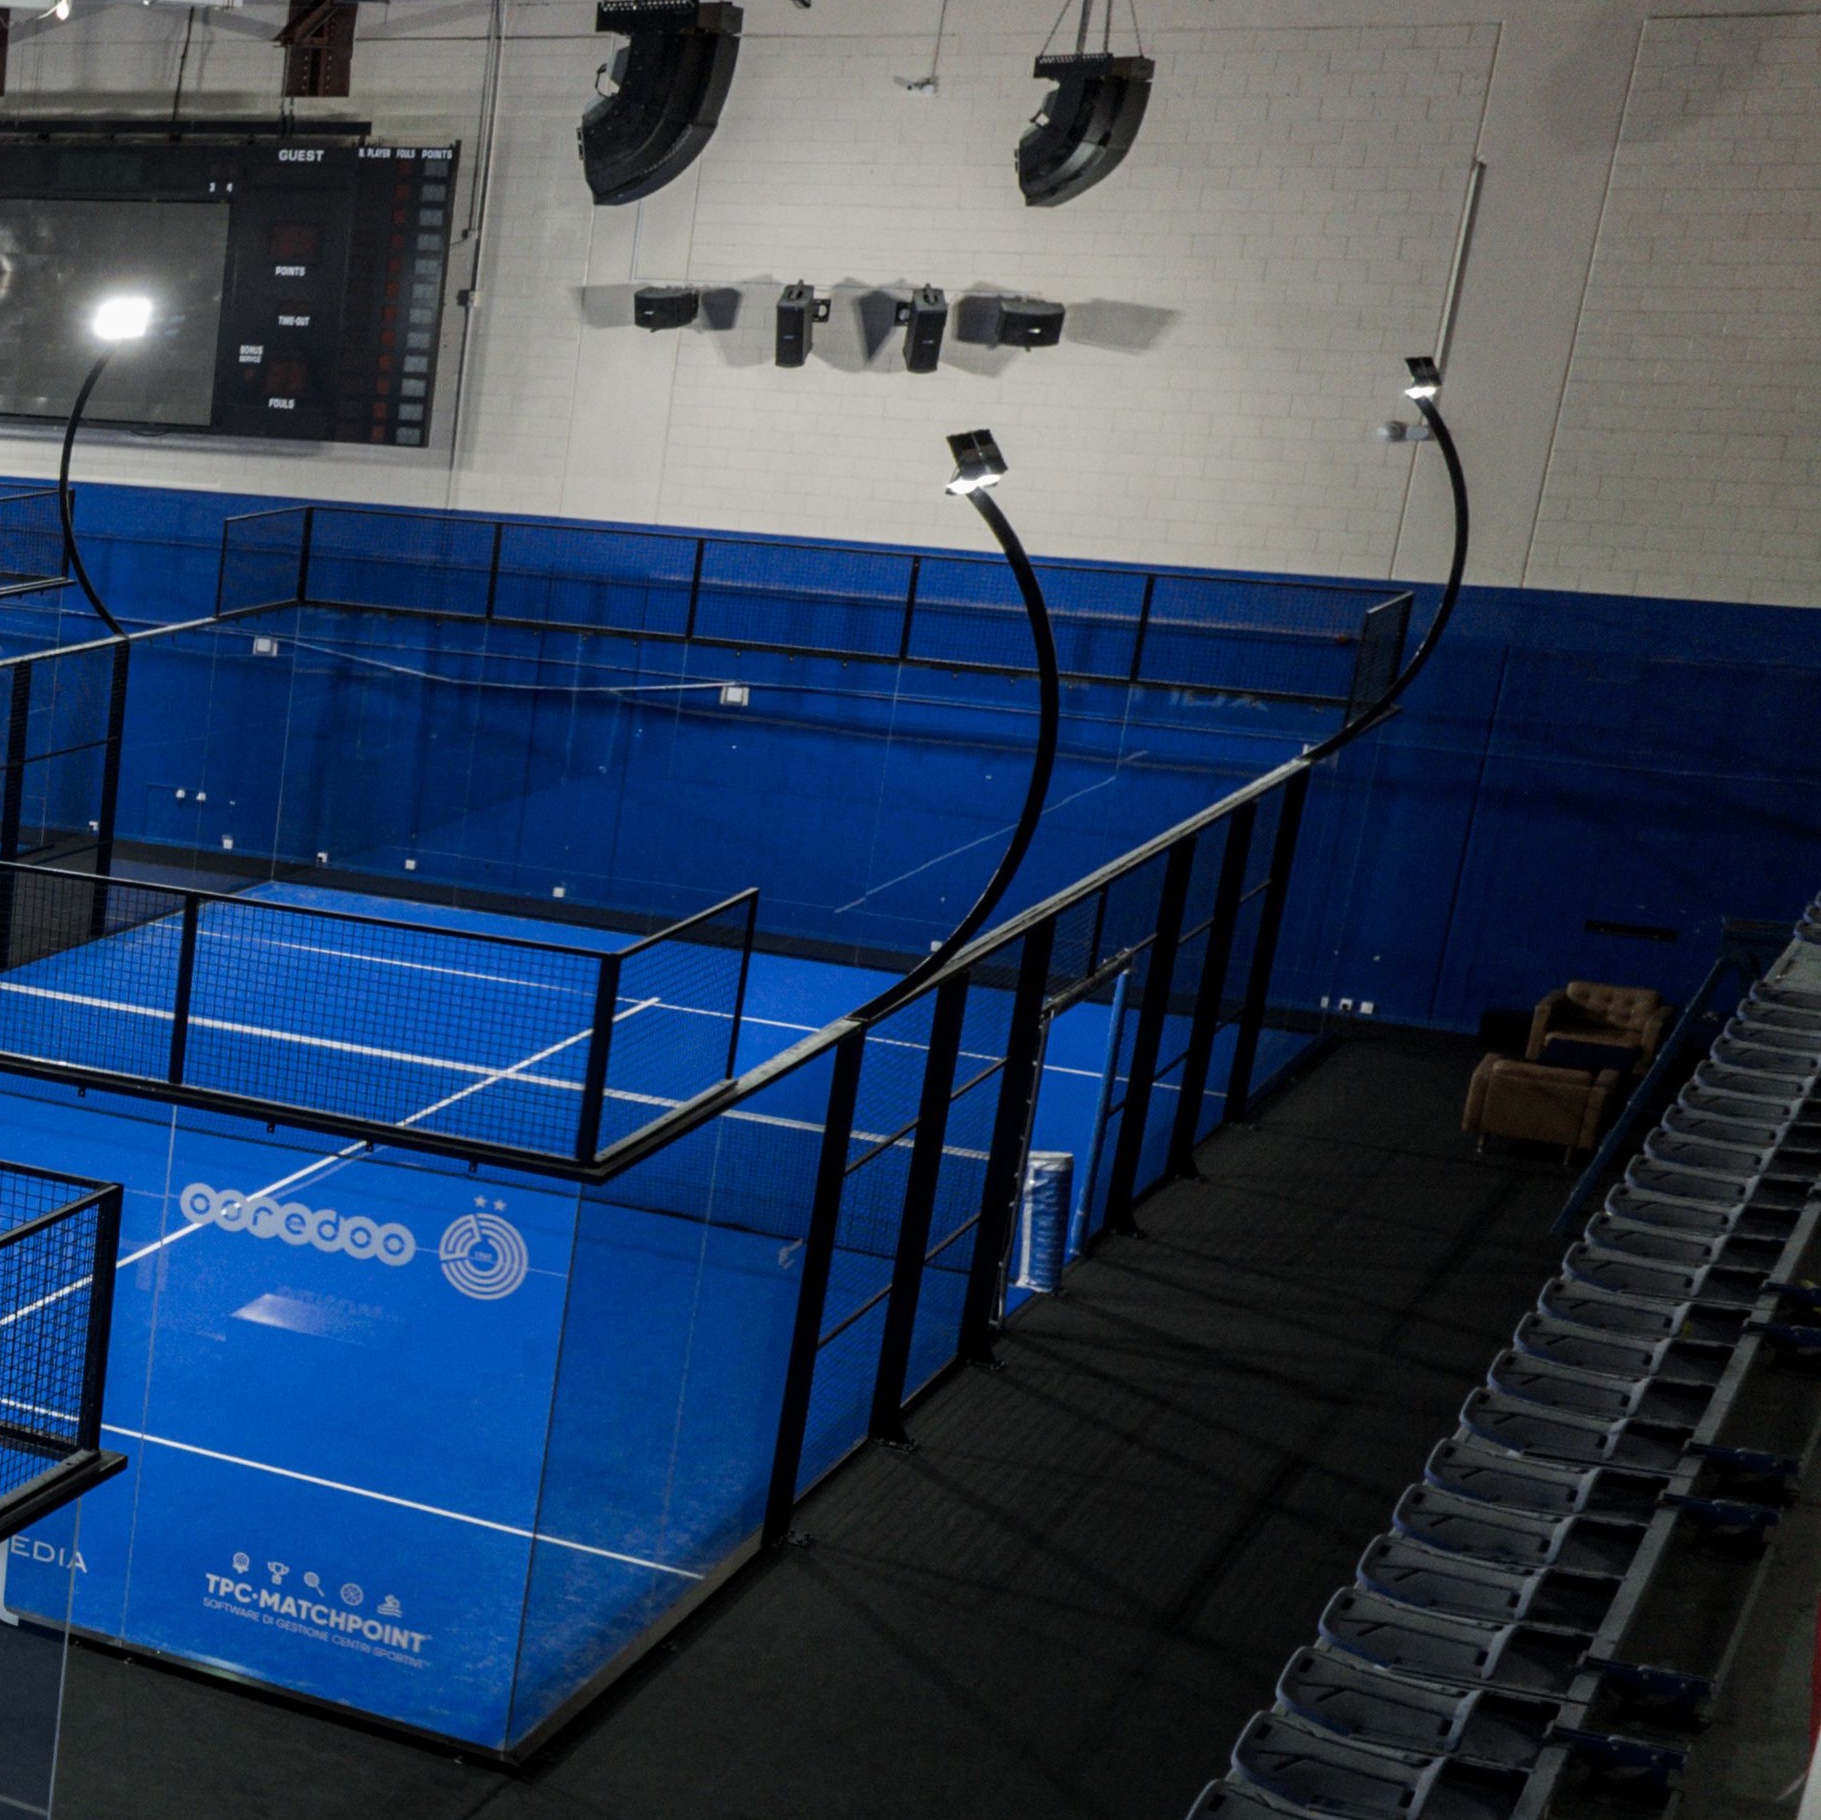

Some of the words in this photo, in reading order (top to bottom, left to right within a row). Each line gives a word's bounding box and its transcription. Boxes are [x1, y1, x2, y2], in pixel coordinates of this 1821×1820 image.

[278, 150, 324, 162] GUEST
[421, 150, 453, 160] POINTS
[209, 182, 215, 192] 3
[226, 182, 233, 192] 4
[275, 266, 306, 277] POINTS
[278, 315, 310, 326] TIME-OUT
[240, 345, 264, 355] BONUS
[268, 398, 295, 409] FOULS
[180, 1182, 416, 1267] ooredoo
[10, 1534, 88, 1574] EDIA
[203, 1597, 260, 1621] SOFTWARE
[262, 1613, 274, 1625] DI
